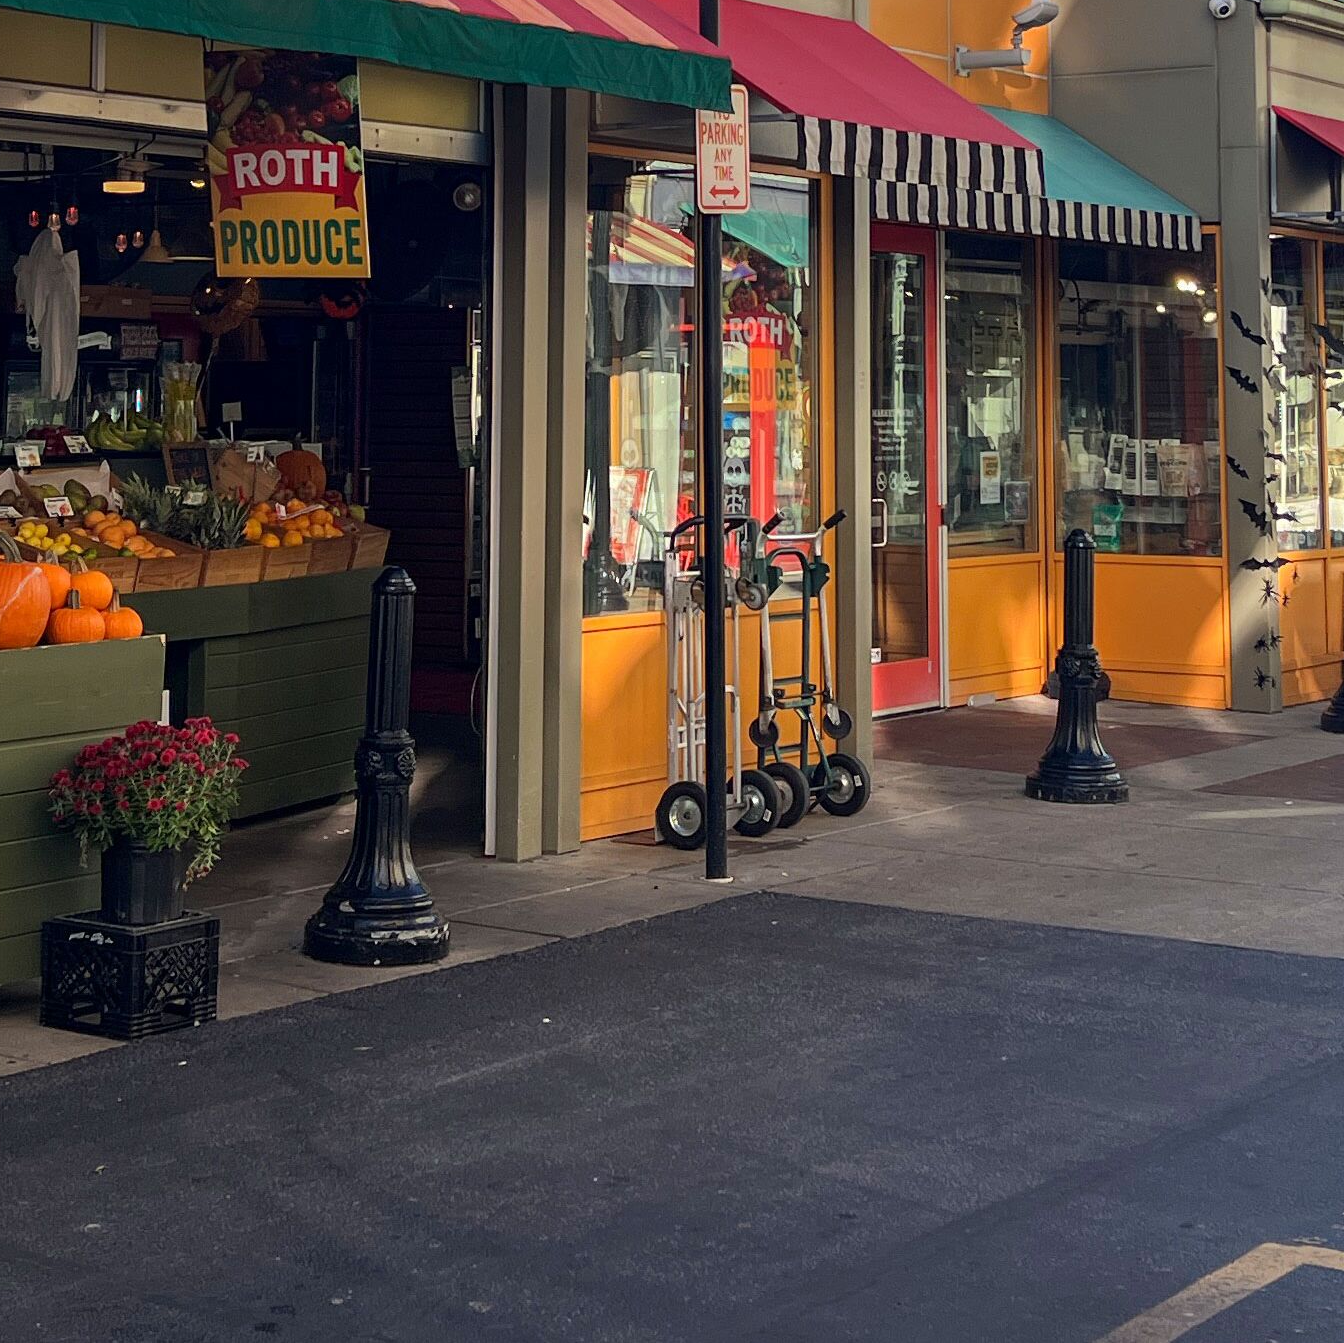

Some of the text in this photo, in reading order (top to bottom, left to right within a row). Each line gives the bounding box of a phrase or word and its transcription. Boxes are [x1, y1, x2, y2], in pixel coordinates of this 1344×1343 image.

[700, 122, 744, 146] PARKING
[233, 149, 339, 189] ROTH
[714, 148, 733, 163] ANY
[714, 165, 735, 181] TIME
[219, 218, 364, 266] PRODUCE
[729, 316, 783, 346] ROTH
